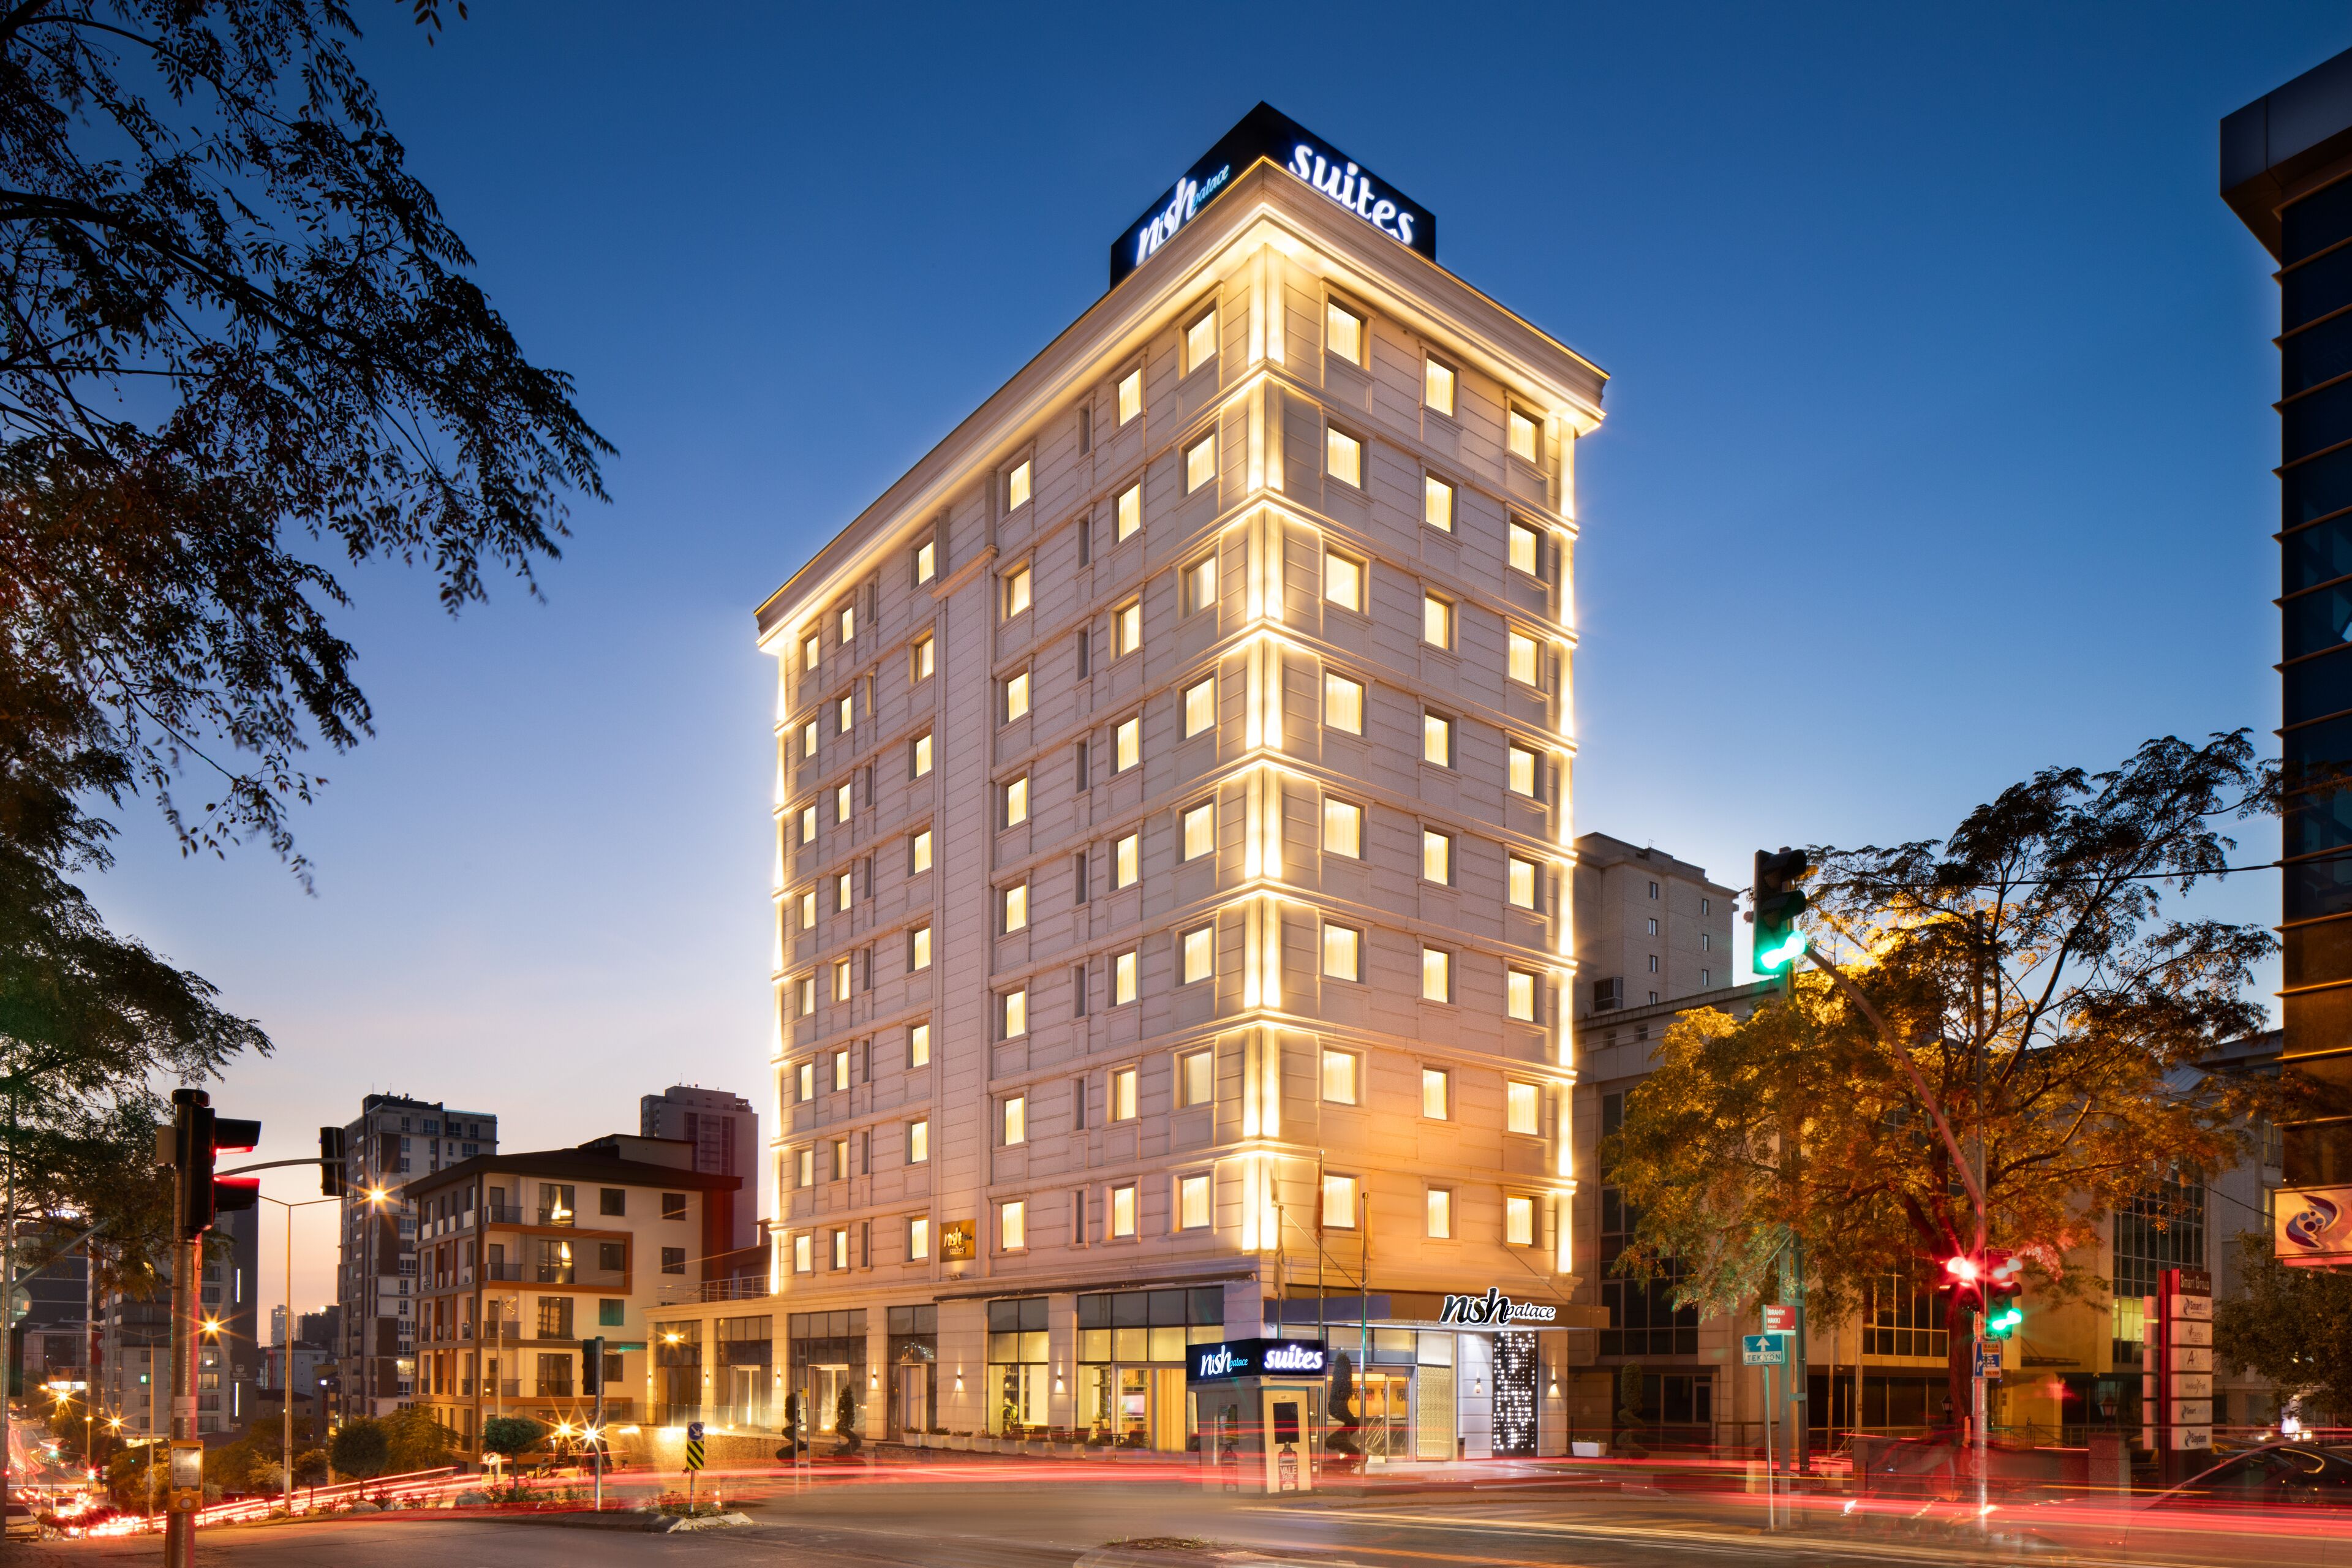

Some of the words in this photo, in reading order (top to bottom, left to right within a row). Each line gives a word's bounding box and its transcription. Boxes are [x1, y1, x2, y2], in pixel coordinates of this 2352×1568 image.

[1288, 144, 1414, 246] suites
[1136, 176, 1197, 267] nish
[1191, 164, 1230, 212] palace
[1439, 1287, 1510, 1325] nish
[1504, 1302, 1556, 1321] palace
[1200, 1344, 1232, 1376] nish
[1229, 1357, 1248, 1368] palace
[1264, 1344, 1323, 1370] suites
[1280, 1466, 1298, 1474] VALE
